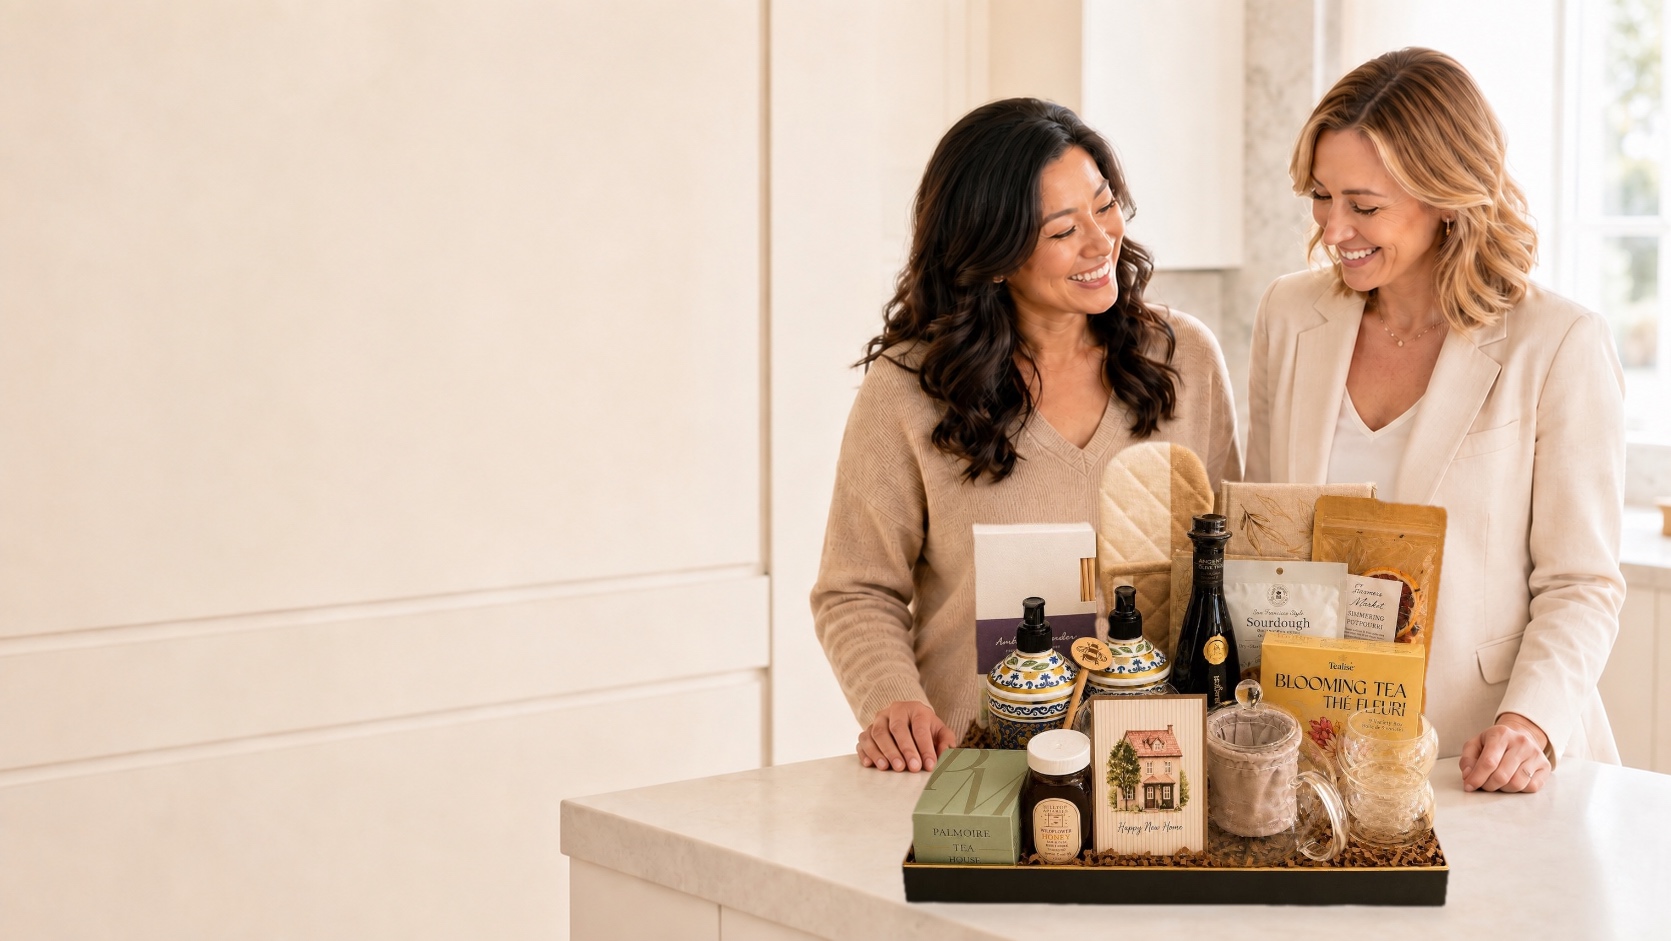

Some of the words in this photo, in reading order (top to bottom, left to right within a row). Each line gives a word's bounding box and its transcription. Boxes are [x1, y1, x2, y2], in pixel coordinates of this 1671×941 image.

[1349, 597, 1385, 610] Market
[1289, 609, 1304, 617] Style
[1347, 610, 1385, 622] SIMMERING
[1246, 616, 1311, 632] Sourdough
[1346, 618, 1384, 630] POTPOURRI
[1275, 673, 1367, 695] BLOOMING
[1373, 681, 1407, 699] TEA
[1323, 695, 1352, 711] THÉ
[1356, 698, 1407, 717] FLEURI
[932, 828, 991, 838] PALMOIRE
[1117, 821, 1143, 836] Happy
[1144, 821, 1160, 833] New
[1162, 821, 1183, 833] Home
[1041, 833, 1071, 841] HONEY
[952, 844, 975, 853] TEA
[948, 856, 982, 864] HOUSE
